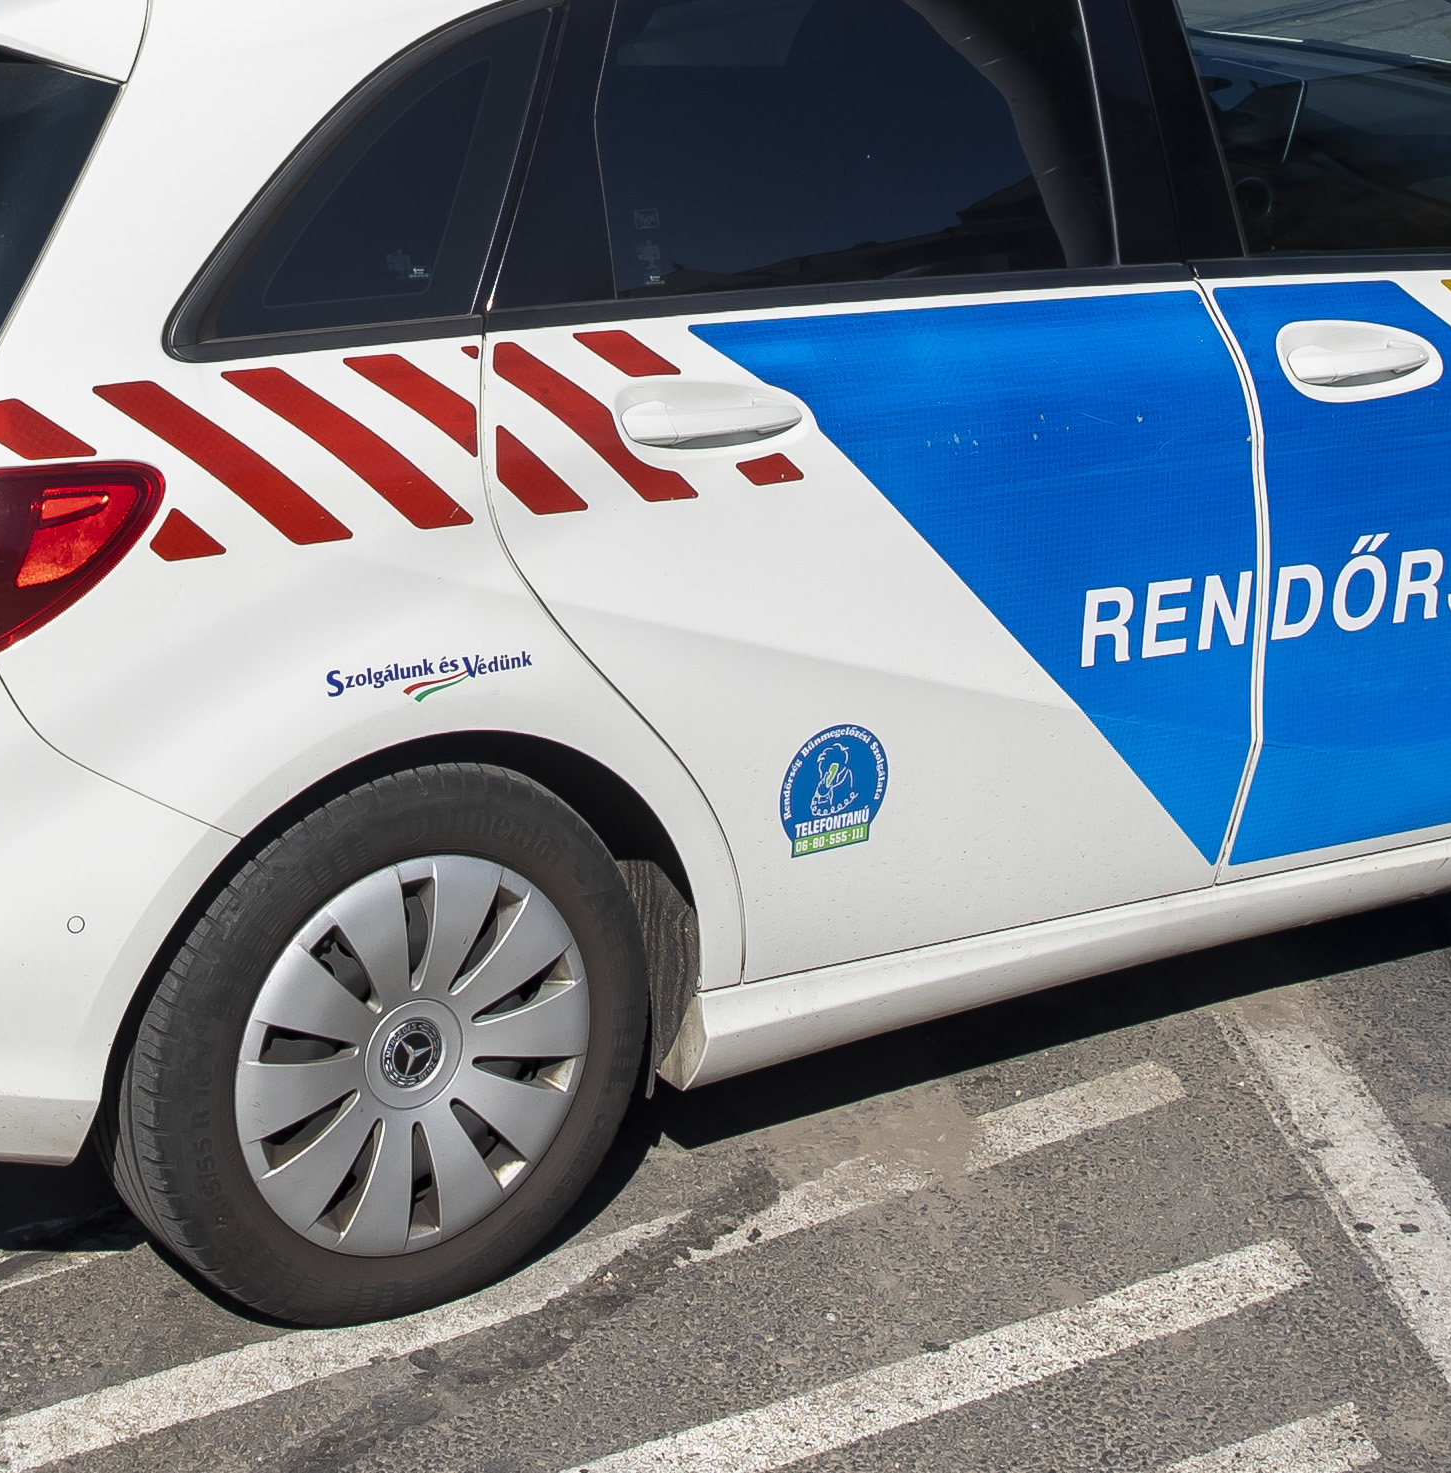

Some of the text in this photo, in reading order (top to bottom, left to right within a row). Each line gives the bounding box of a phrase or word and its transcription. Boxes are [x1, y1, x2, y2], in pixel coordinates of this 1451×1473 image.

[326, 650, 533, 698] Szolgálunk és Védünk
[794, 804, 870, 838] TELEFONTANÚ
[385, 1022, 418, 1058] MERCEDES
